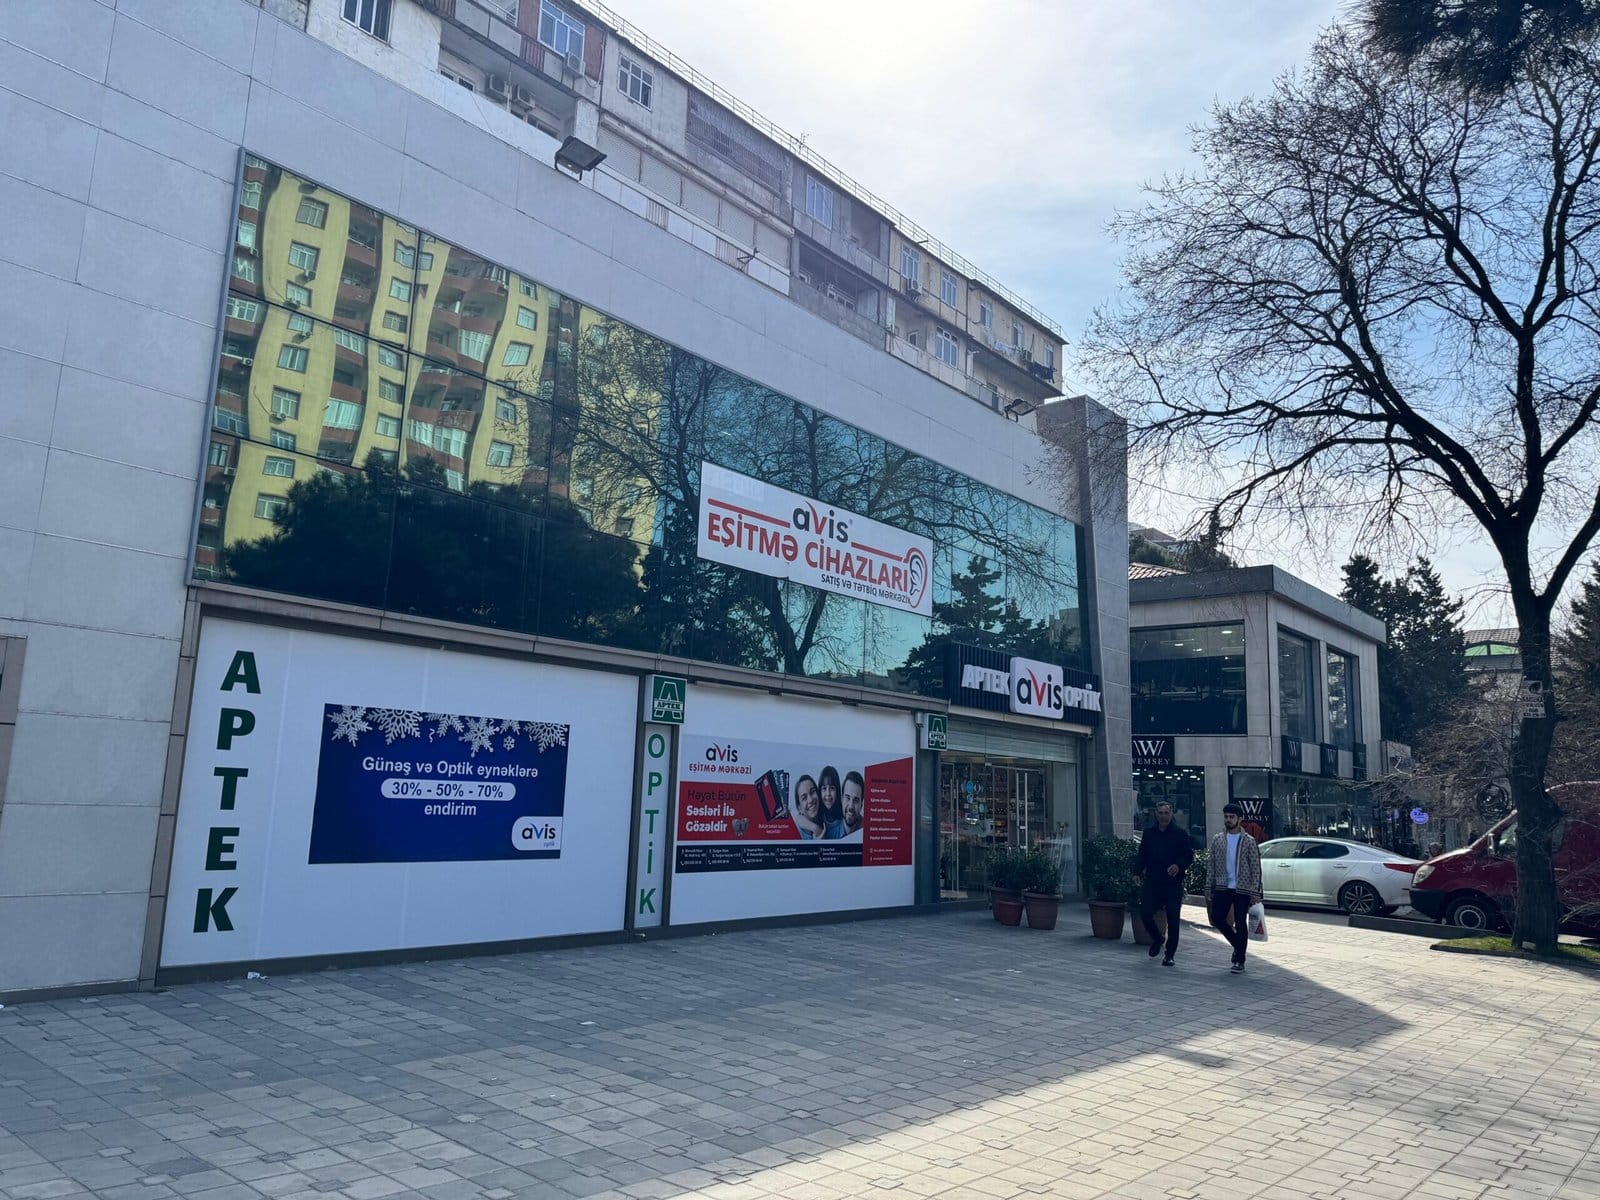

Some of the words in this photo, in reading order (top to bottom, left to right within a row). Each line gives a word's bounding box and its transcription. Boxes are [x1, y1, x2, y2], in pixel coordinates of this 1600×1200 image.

[793, 501, 849, 543] avis
[708, 512, 798, 562] EŞİTMƏ
[805, 539, 908, 592] CİHAZLARI
[821, 574, 840, 588] SATIŞ
[842, 579, 852, 589] VƏ
[854, 583, 877, 596] TƏTBİQ
[961, 664, 1010, 695] APTEK
[1017, 667, 1062, 710] avis
[656, 702, 681, 710] APTEK
[706, 743, 738, 762] avis
[362, 757, 410, 775] Günəş
[416, 762, 432, 773] və
[437, 760, 473, 777] Optik
[477, 764, 538, 778] eynəklərə
[689, 762, 716, 773] EŞİTMƏ
[719, 765, 752, 774] MƏRKƏZİ
[193, 650, 261, 933] APTEK
[392, 782, 422, 796] 30%
[436, 784, 464, 797] 50%
[477, 785, 503, 798] 70%
[424, 802, 477, 816] endirim
[686, 804, 721, 816] Səsləri
[1242, 814, 1269, 822] EMSEY
[522, 822, 556, 840] avis
[639, 734, 665, 914] OPTİK
[686, 820, 727, 832] Gözəldir
